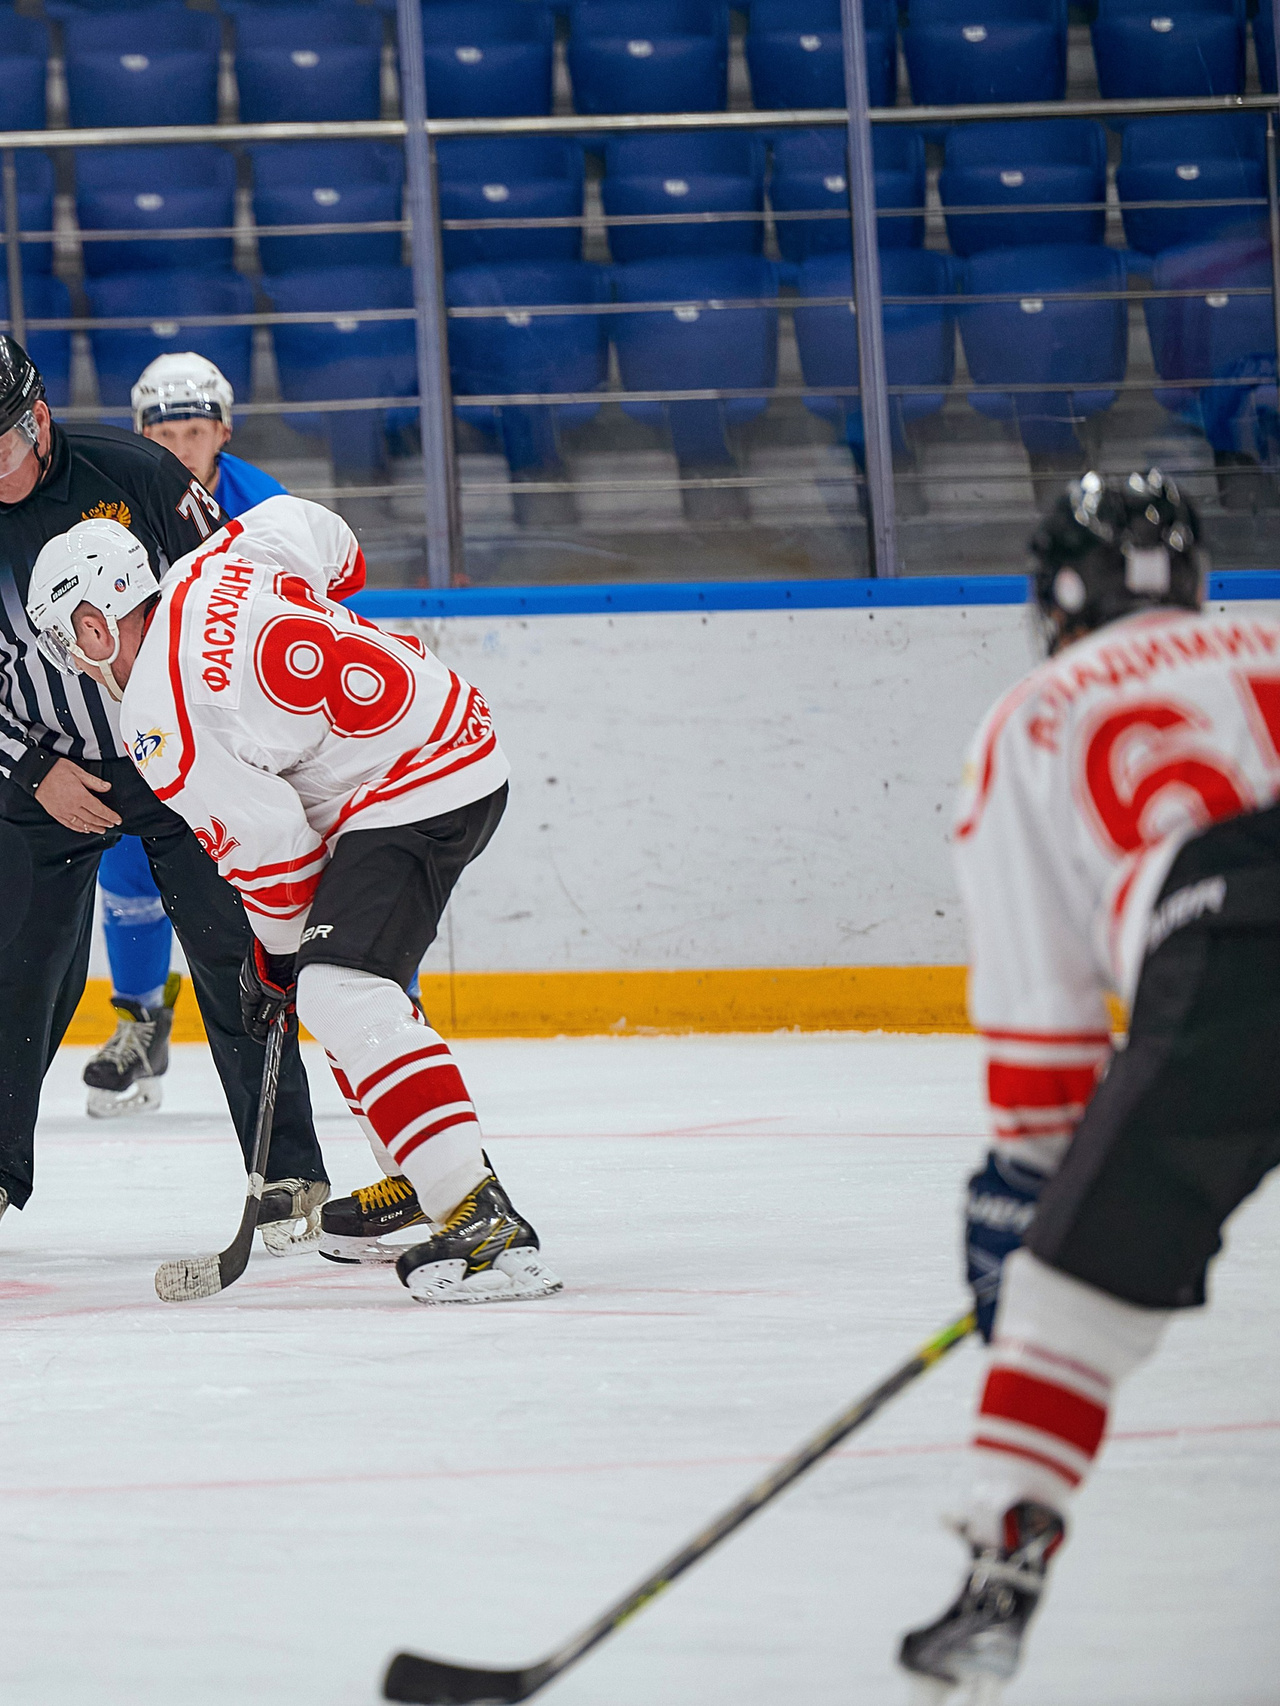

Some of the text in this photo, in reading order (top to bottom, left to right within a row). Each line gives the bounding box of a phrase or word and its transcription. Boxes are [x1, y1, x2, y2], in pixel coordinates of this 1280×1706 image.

[175, 478, 222, 541] 73
[51, 578, 79, 602] BAUER
[380, 1210, 403, 1223] CCM
